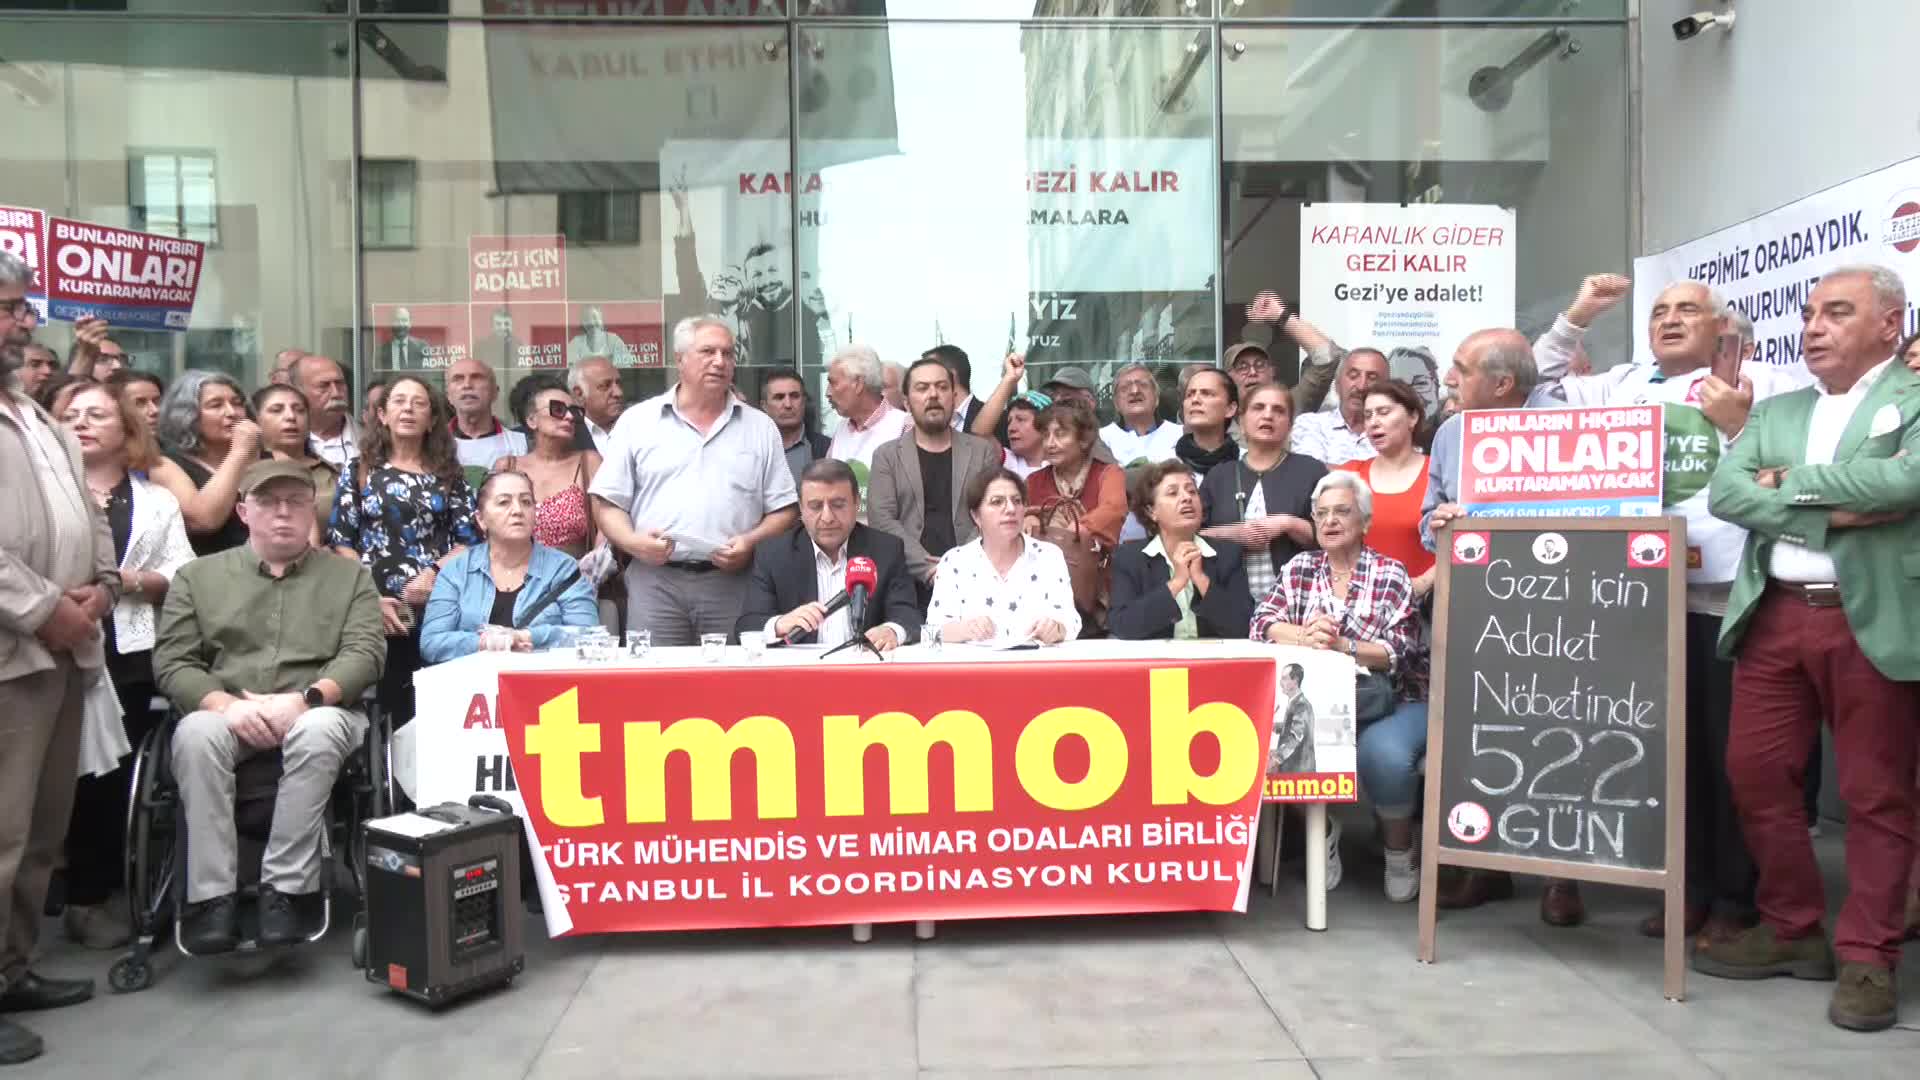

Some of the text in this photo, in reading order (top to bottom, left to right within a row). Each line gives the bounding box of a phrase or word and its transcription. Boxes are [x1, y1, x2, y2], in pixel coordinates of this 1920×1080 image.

[1027, 164, 1077, 192] EZİ
[1090, 171, 1179, 192] KALIR
[1027, 209, 1130, 225] MALARA
[56, 223, 144, 249] BUNLARIN
[1311, 224, 1504, 246] KARANLIK GİDER
[1755, 210, 1869, 274] ORADAYDIK.
[56, 245, 197, 288] ONLARI
[1346, 249, 1467, 272] GEZİ KALIR
[58, 279, 192, 302] KURTARAMAYACAK
[474, 268, 561, 292] ADALET!
[1414, 284, 1483, 302] adalet!
[517, 354, 562, 368] ADALET!
[1471, 413, 1573, 434] BUNLARIN
[1472, 431, 1654, 474] ONLARI
[1475, 472, 1655, 494] KURTARAMAYACAK
[1485, 558, 1649, 608] Gezi için
[1475, 613, 1600, 661] Adalet
[1473, 670, 1657, 729] Nöbetinde
[524, 668, 1259, 827] tmmob
[1470, 723, 1659, 807] 522.
[633, 830, 808, 866] MÜHENDİS
[816, 833, 860, 860] VE
[868, 826, 977, 857] MİMAR
[987, 823, 1132, 852] ODALARI
[1497, 803, 1625, 858] GÜN
[741, 872, 774, 898] İL
[788, 864, 1093, 897] KOORDİNASYON
